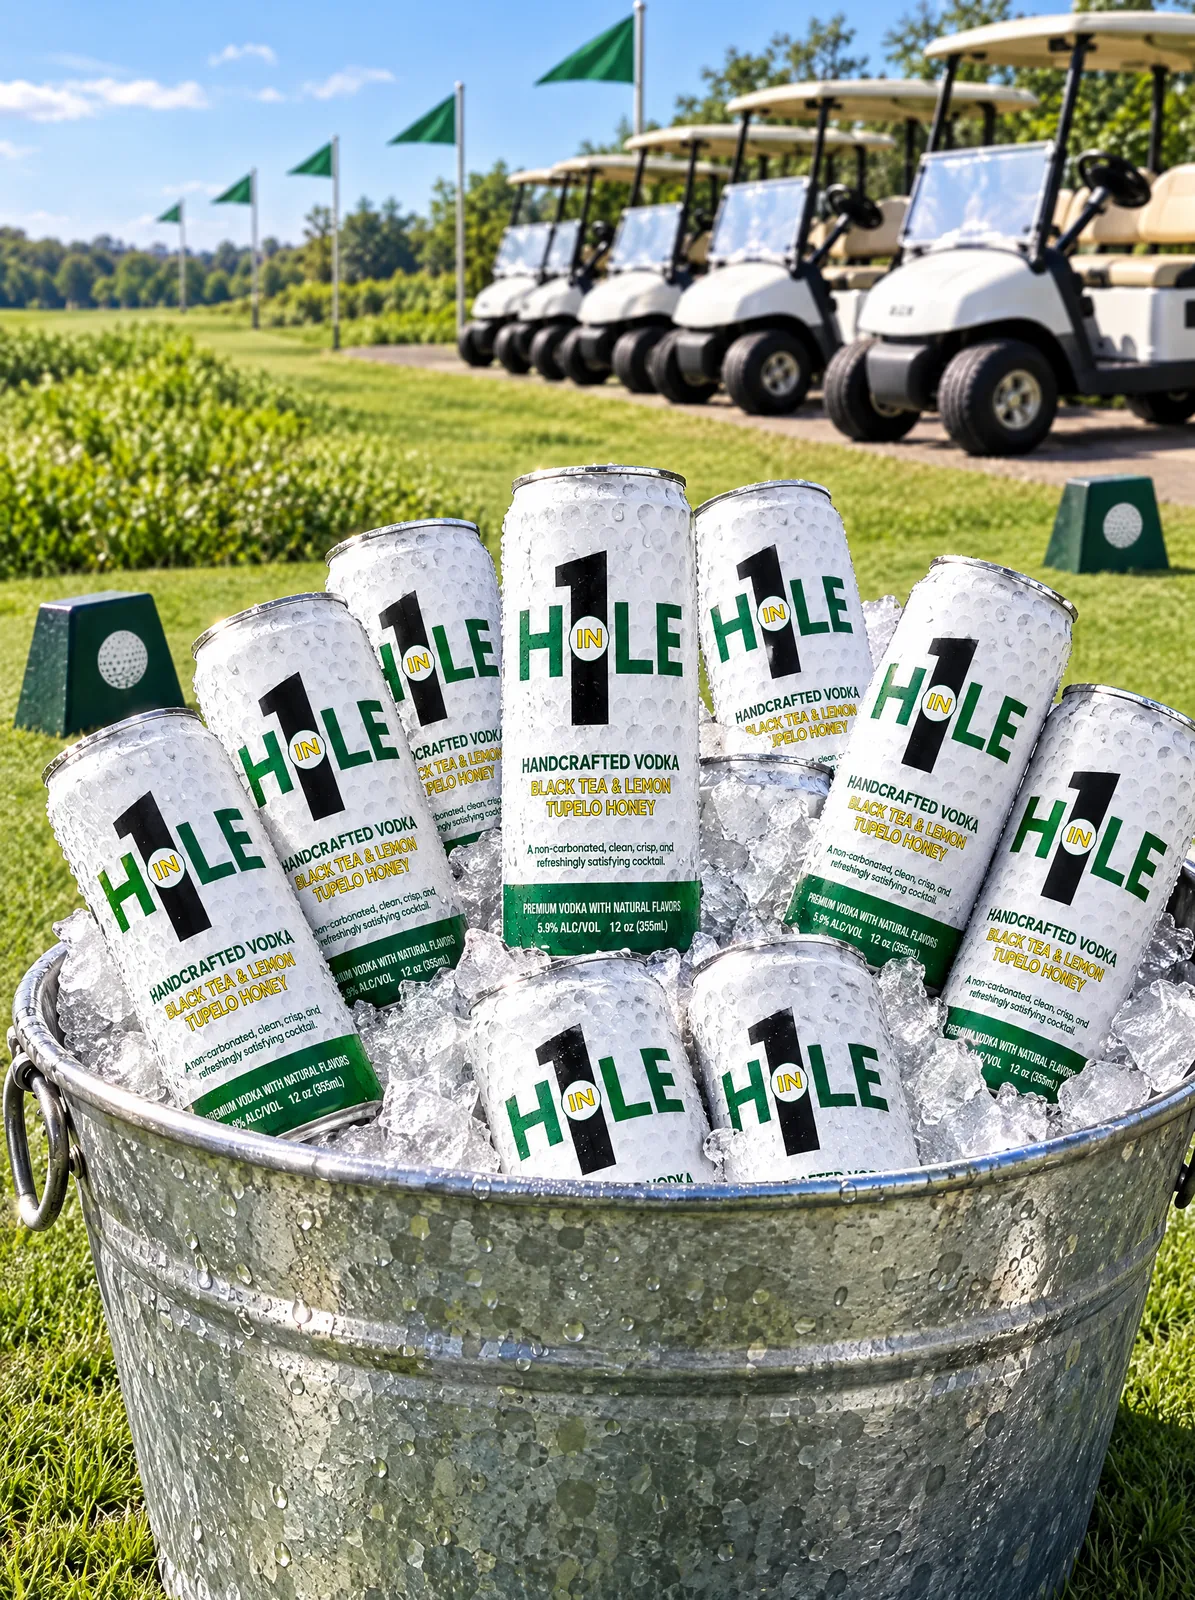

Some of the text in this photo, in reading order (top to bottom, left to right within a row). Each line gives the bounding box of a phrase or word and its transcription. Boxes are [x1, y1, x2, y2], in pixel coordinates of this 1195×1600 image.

[763, 604, 785, 624] IN
[576, 628, 602, 649] IN
[406, 653, 430, 673] IN
[735, 687, 860, 723] HANDCRAFTED VODKA
[783, 703, 857, 726] TEA & LEMON
[927, 693, 952, 715] IN
[809, 720, 847, 738] HONEY
[294, 737, 321, 761] IN
[433, 756, 457, 774] TEA
[457, 754, 467, 767] &
[457, 764, 495, 786] HONEY
[522, 754, 679, 772] HANDCRAFTED VODKA
[531, 778, 670, 795] BLACK TEA & LEMON
[546, 799, 655, 816] TUPELO HONEY
[847, 774, 978, 833] HANDCRAFTED VODKA
[451, 810, 484, 826] satisfying
[848, 795, 968, 849] BLACK TEA & LEMON
[280, 815, 417, 874] HANDCRAFTED VODKA
[527, 842, 673, 854] A non-carbonated, clean, crisp, and
[854, 816, 949, 861] TUPELO HONEY
[1066, 827, 1092, 848] IN
[152, 855, 180, 880] IN
[294, 835, 417, 890] BLACK TEA & LEMON
[537, 856, 664, 868] refreshingly satisfying cocktail.
[312, 857, 409, 902] TUPELO HONEY
[422, 886, 436, 897] and
[831, 859, 937, 904] refreshingly satisfying cocktail.
[937, 886, 952, 896] and
[523, 901, 680, 914] PREMIUM VODKA WITH NATURAL FLAVORS
[808, 892, 939, 948] PREMIUM VODKA WITH NATURAL FLAVORS
[320, 900, 431, 946] refreshingly satisfying cocktail.
[537, 920, 667, 932] 5.9% ALC/VOL 12 oz (355mL)
[813, 912, 921, 959] 5.9% ALC/VOL 12 oz (355mL)
[987, 907, 1116, 967] HANDCRAFTED VODKA
[149, 929, 294, 1004] HANDCRAFTED VODKA
[351, 942, 429, 976] VODKA WITH NATURAL
[987, 926, 1106, 981] BLACK TEA & LEMON
[359, 953, 450, 992] ALC/VOL 12 (355mL)
[993, 947, 1088, 991] TUPELO HONEY
[164, 951, 296, 1019] BLACK TEA & LEMON
[184, 974, 288, 1030] TUPELO HONEY
[305, 1004, 321, 1016] and
[970, 989, 1076, 1035] refreshingly satisfying cocktail.
[1076, 1017, 1090, 1028] and
[198, 1020, 317, 1079] refreshingly satisfying cocktail.
[977, 1031, 1049, 1067] VODKA WITH NATURAL
[236, 1054, 349, 1106] VODKA WITH NATURAL FLAVORS
[776, 1072, 803, 1093] IN
[1009, 1063, 1059, 1091] 12 (355mL)
[245, 1099, 283, 1124] ALC/VOL
[287, 1091, 301, 1105] 12
[312, 1075, 345, 1096] (355mL)
[568, 1088, 595, 1112] IN
